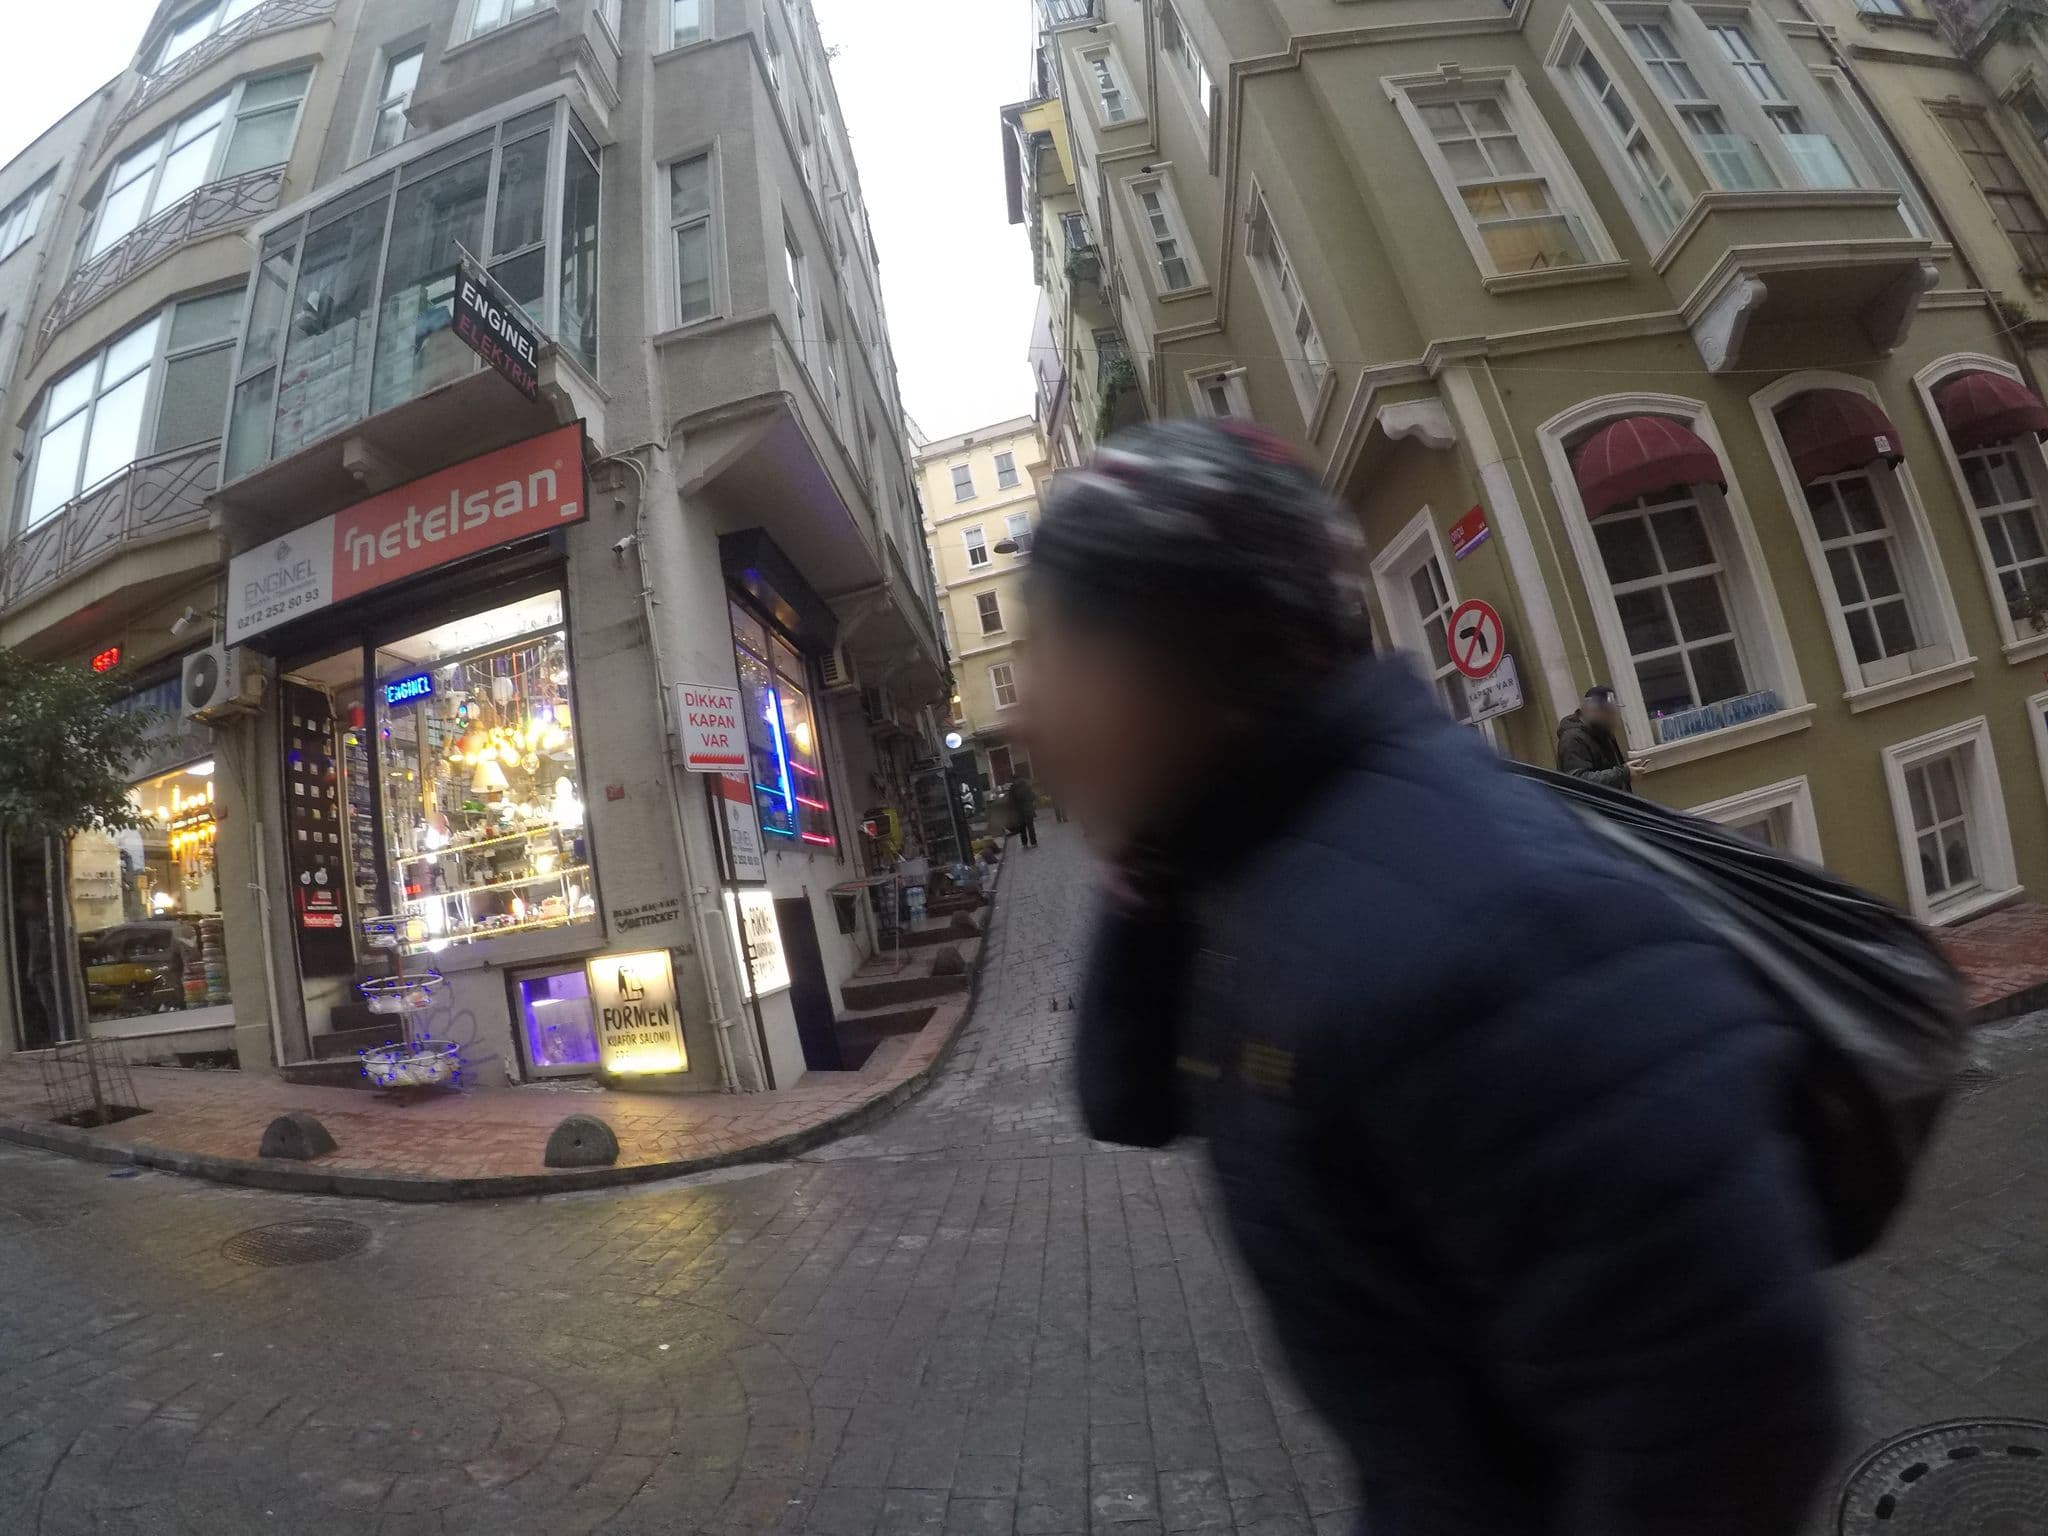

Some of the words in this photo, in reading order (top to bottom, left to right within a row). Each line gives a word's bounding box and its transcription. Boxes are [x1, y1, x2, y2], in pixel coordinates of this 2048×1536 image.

[461, 281, 537, 369] ENGİNEL
[344, 468, 558, 571] netelsan
[238, 611, 262, 629] 0212
[265, 601, 286, 618] 252
[305, 588, 319, 603] 93
[1496, 678, 1514, 690] VAR
[685, 690, 733, 709] DİKKAT
[689, 713, 735, 729] KAPAN
[701, 733, 729, 747] VAR
[603, 1003, 669, 1031] FORMEN
